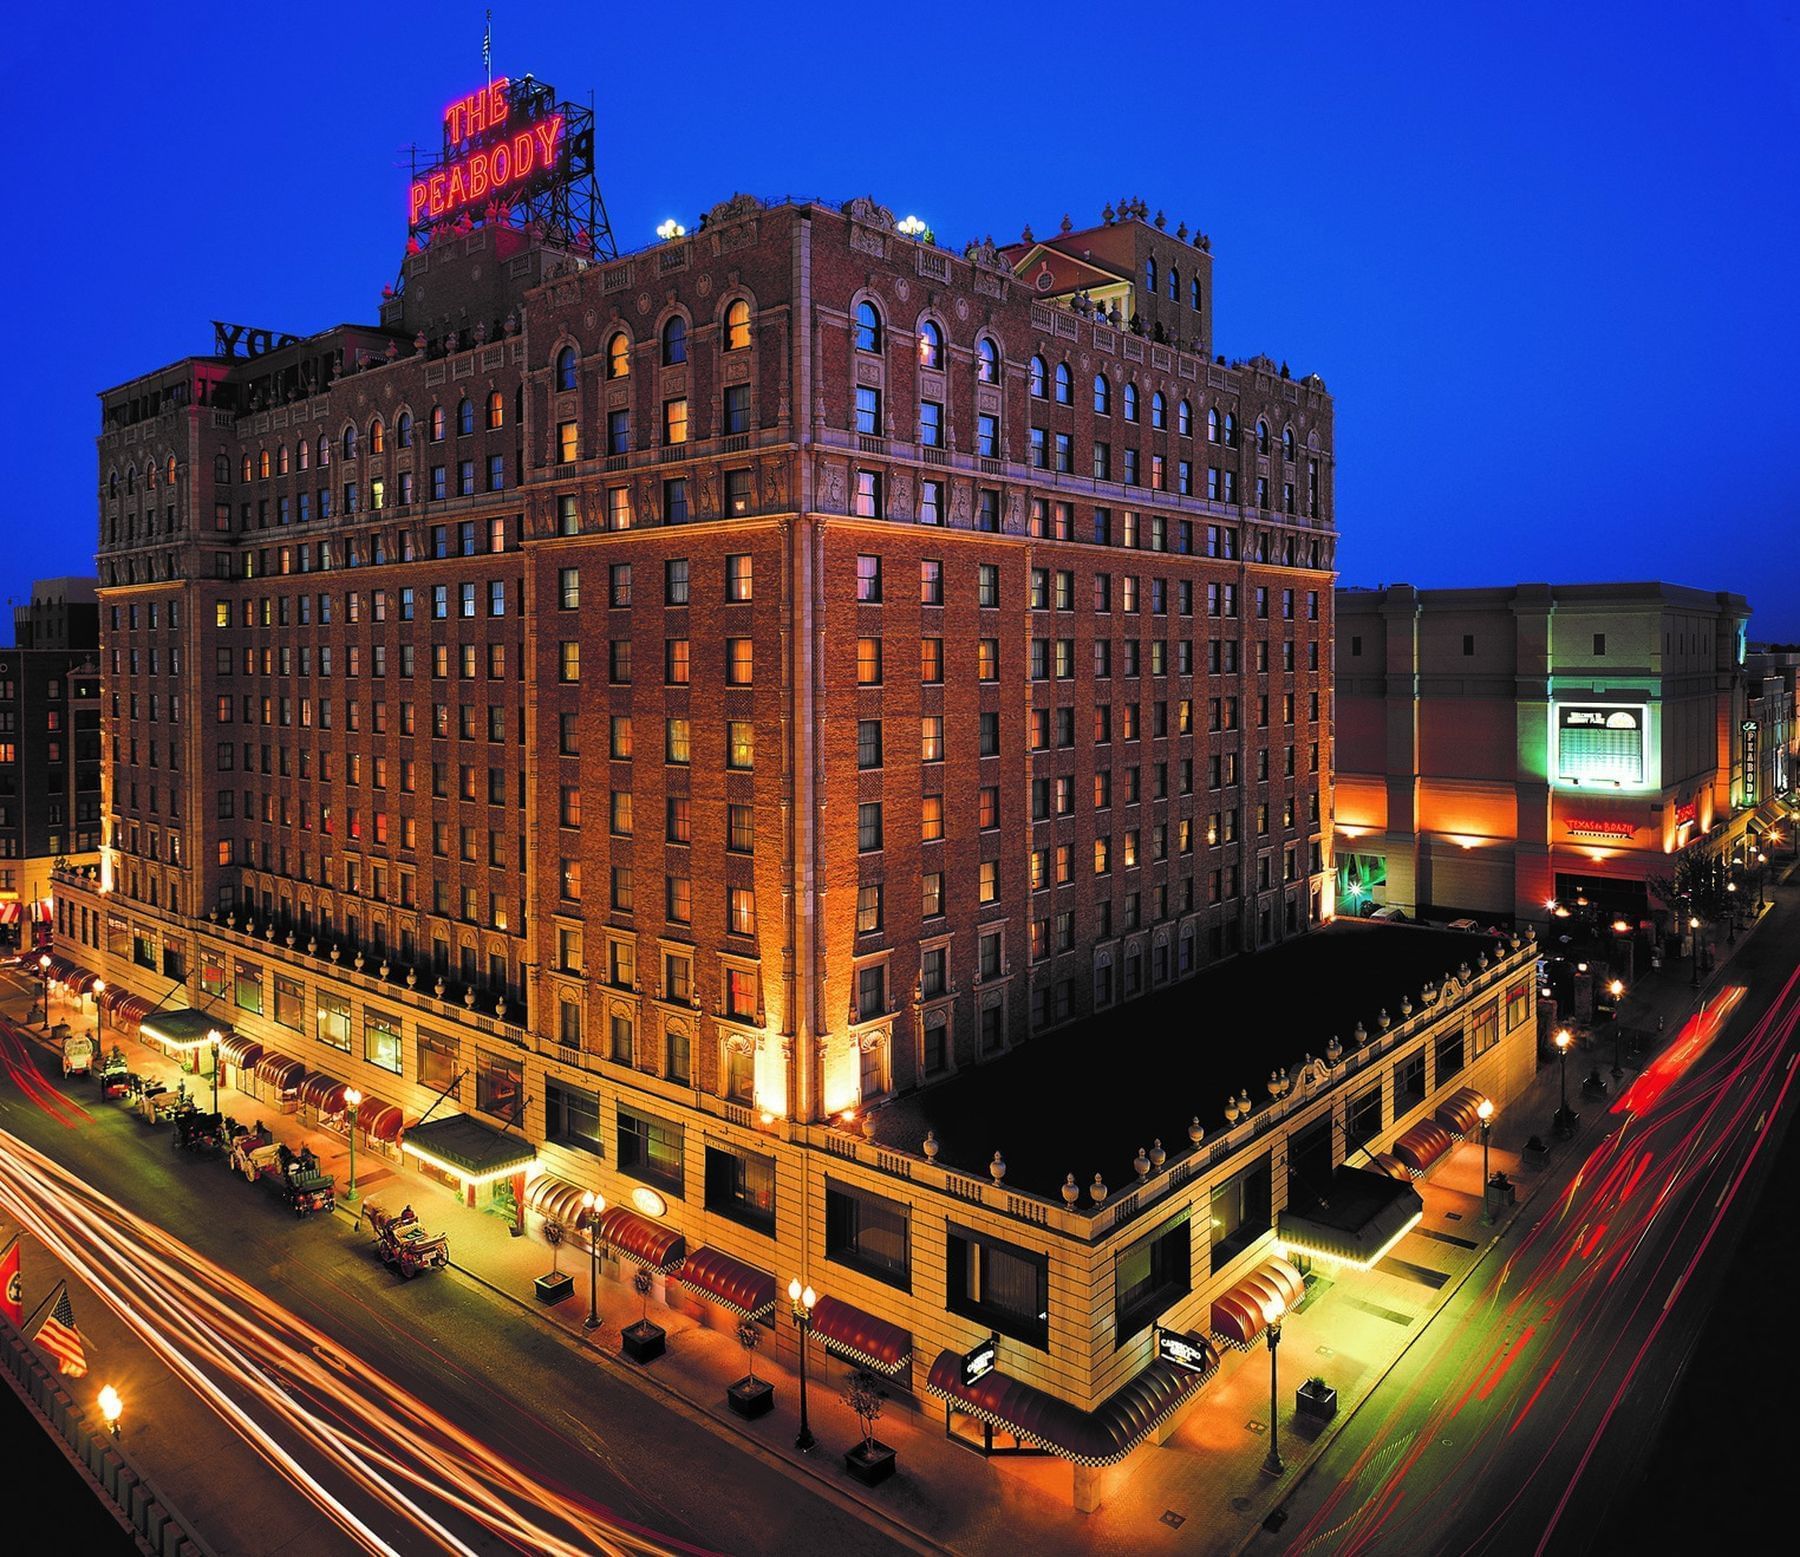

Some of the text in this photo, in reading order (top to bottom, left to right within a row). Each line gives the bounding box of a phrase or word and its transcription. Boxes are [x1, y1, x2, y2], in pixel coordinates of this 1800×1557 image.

[446, 77, 509, 144] THE
[410, 116, 562, 225] PEABODY
[1745, 730, 1755, 803] PEABODY
[1566, 819, 1595, 830] TEXAS
[1603, 821, 1633, 835] BRAZIL
